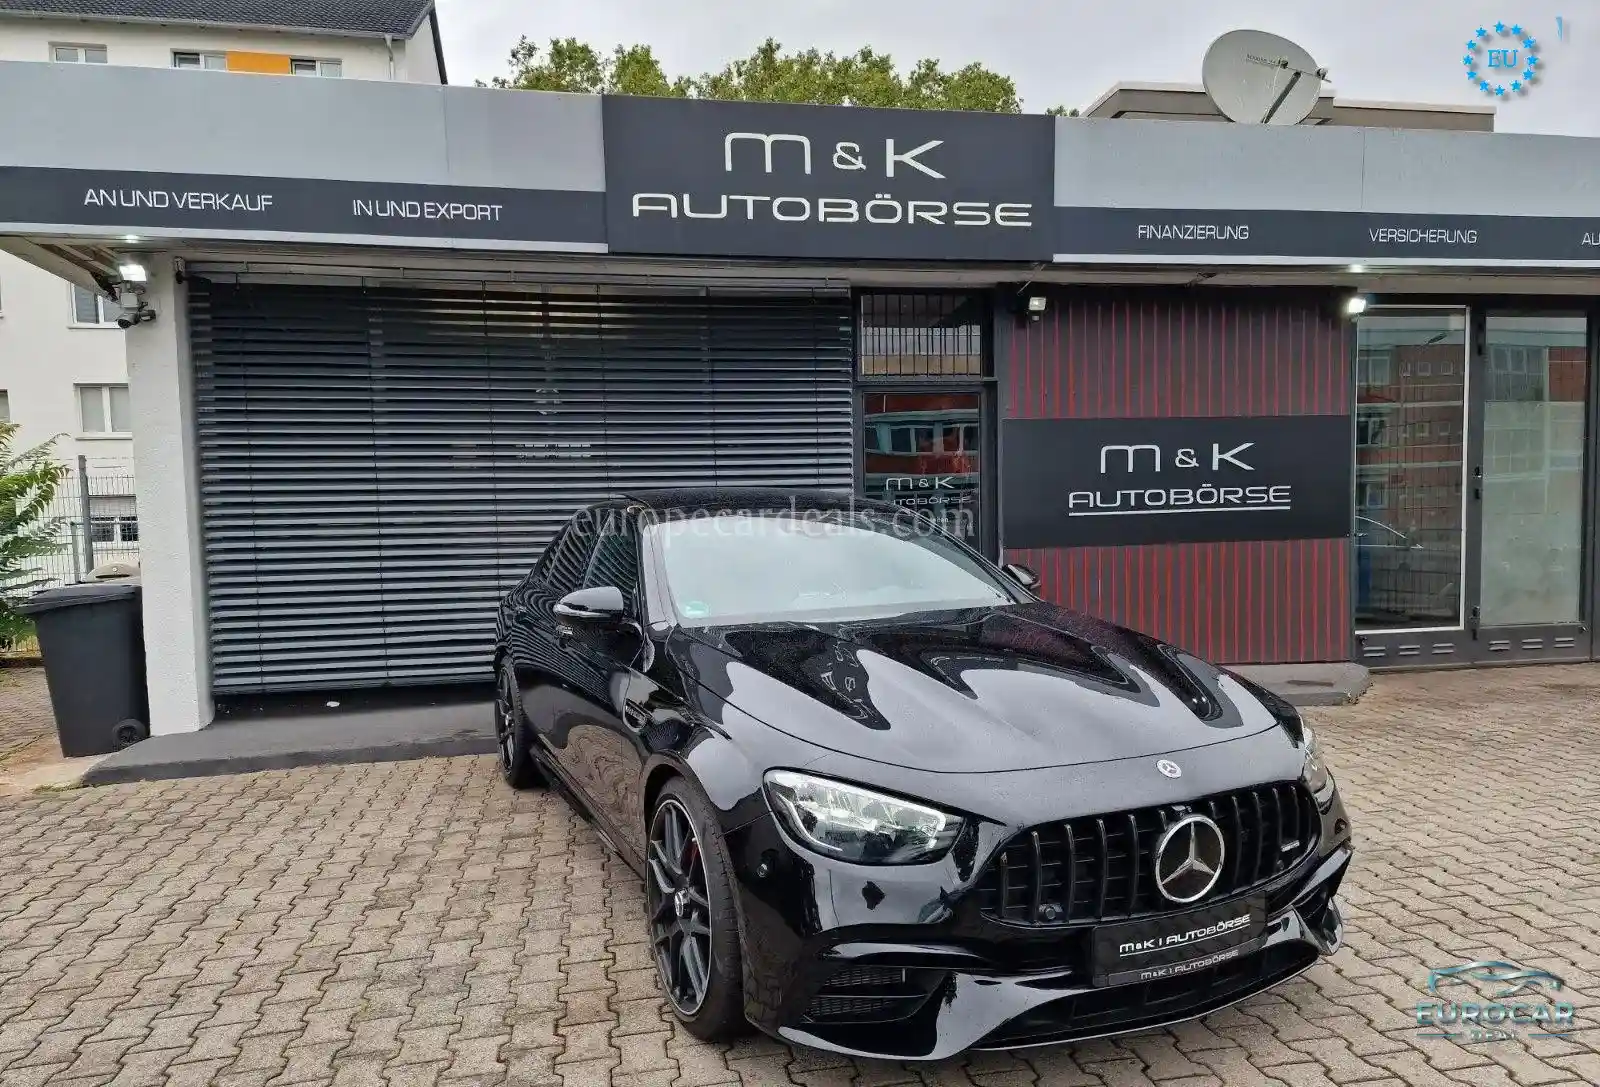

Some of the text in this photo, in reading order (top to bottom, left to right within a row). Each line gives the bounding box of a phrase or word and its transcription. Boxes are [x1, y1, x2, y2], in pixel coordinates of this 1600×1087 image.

[725, 132, 947, 179] M & K
[83, 188, 273, 212] AN UND VERKAUF
[352, 199, 503, 221] IN UND EXPORT
[632, 192, 1033, 227] AUTOBÖRSE
[1137, 224, 1249, 240] FINANZIERUNG
[1369, 228, 1478, 244] VERSICHERUNG
[1100, 442, 1255, 474] M & K
[885, 476, 955, 491] M & K
[1068, 483, 1292, 508] AUTOBÖRSE
[1166, 914, 1251, 945] AUTOBÖRSE
[1175, 949, 1239, 974] AUTOBÖRSE
